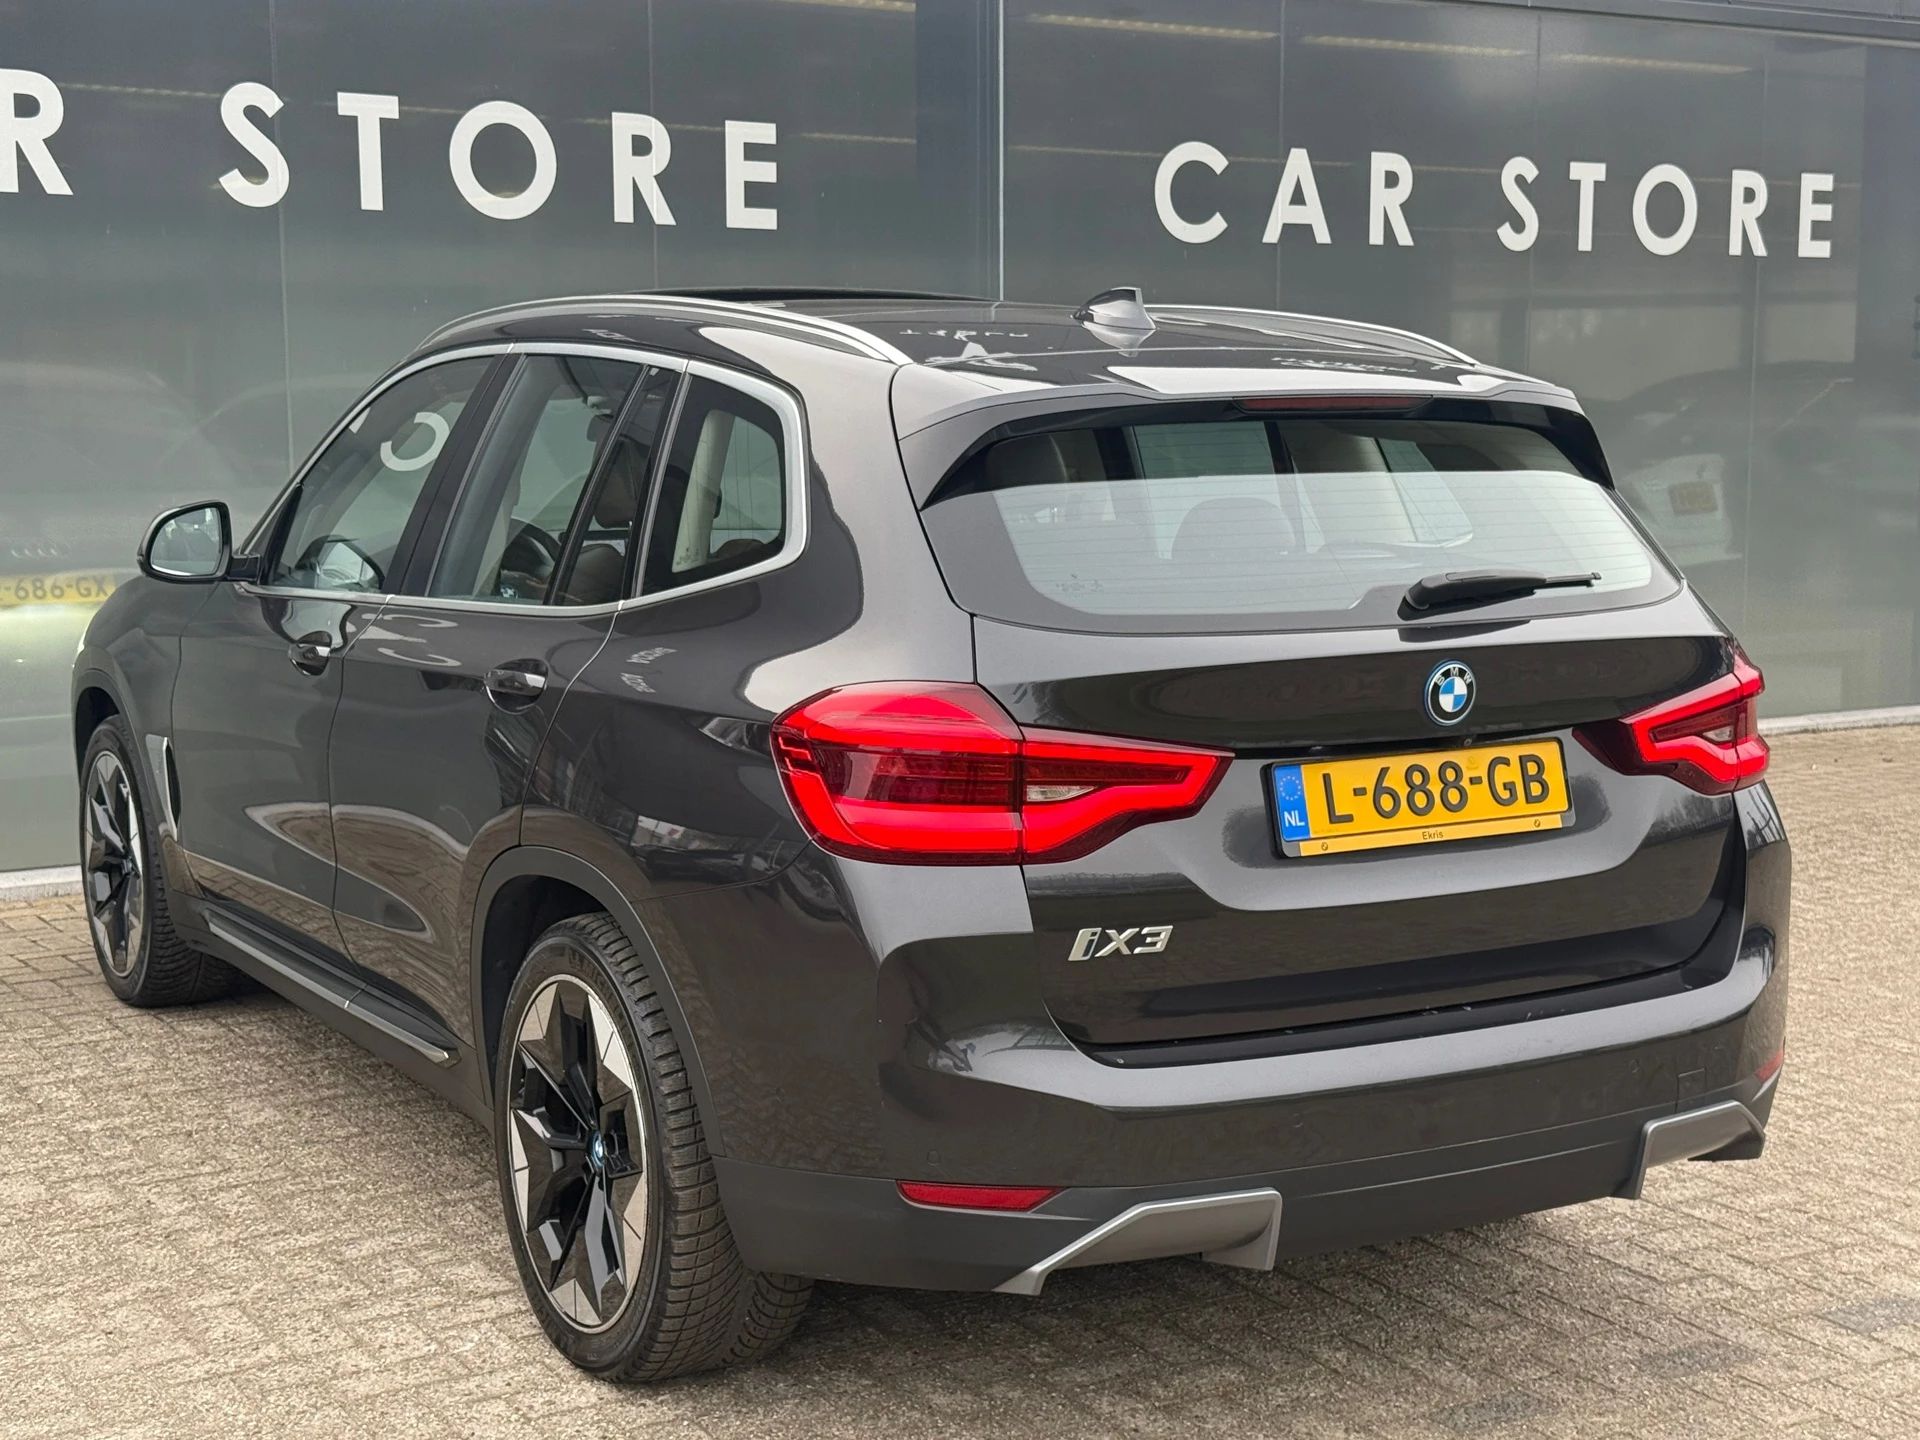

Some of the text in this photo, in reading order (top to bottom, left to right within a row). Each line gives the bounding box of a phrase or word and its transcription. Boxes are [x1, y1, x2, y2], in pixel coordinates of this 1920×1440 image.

[218, 81, 779, 231] STORE
[1154, 140, 1835, 259] CAR STORE
[0, 576, 109, 601] -686-GX
[1435, 667, 1472, 687] BMW
[1322, 754, 1550, 825] L-688-GB
[1284, 810, 1305, 828] NL
[1422, 829, 1444, 841] Ekris
[1068, 925, 1173, 961] iX3
